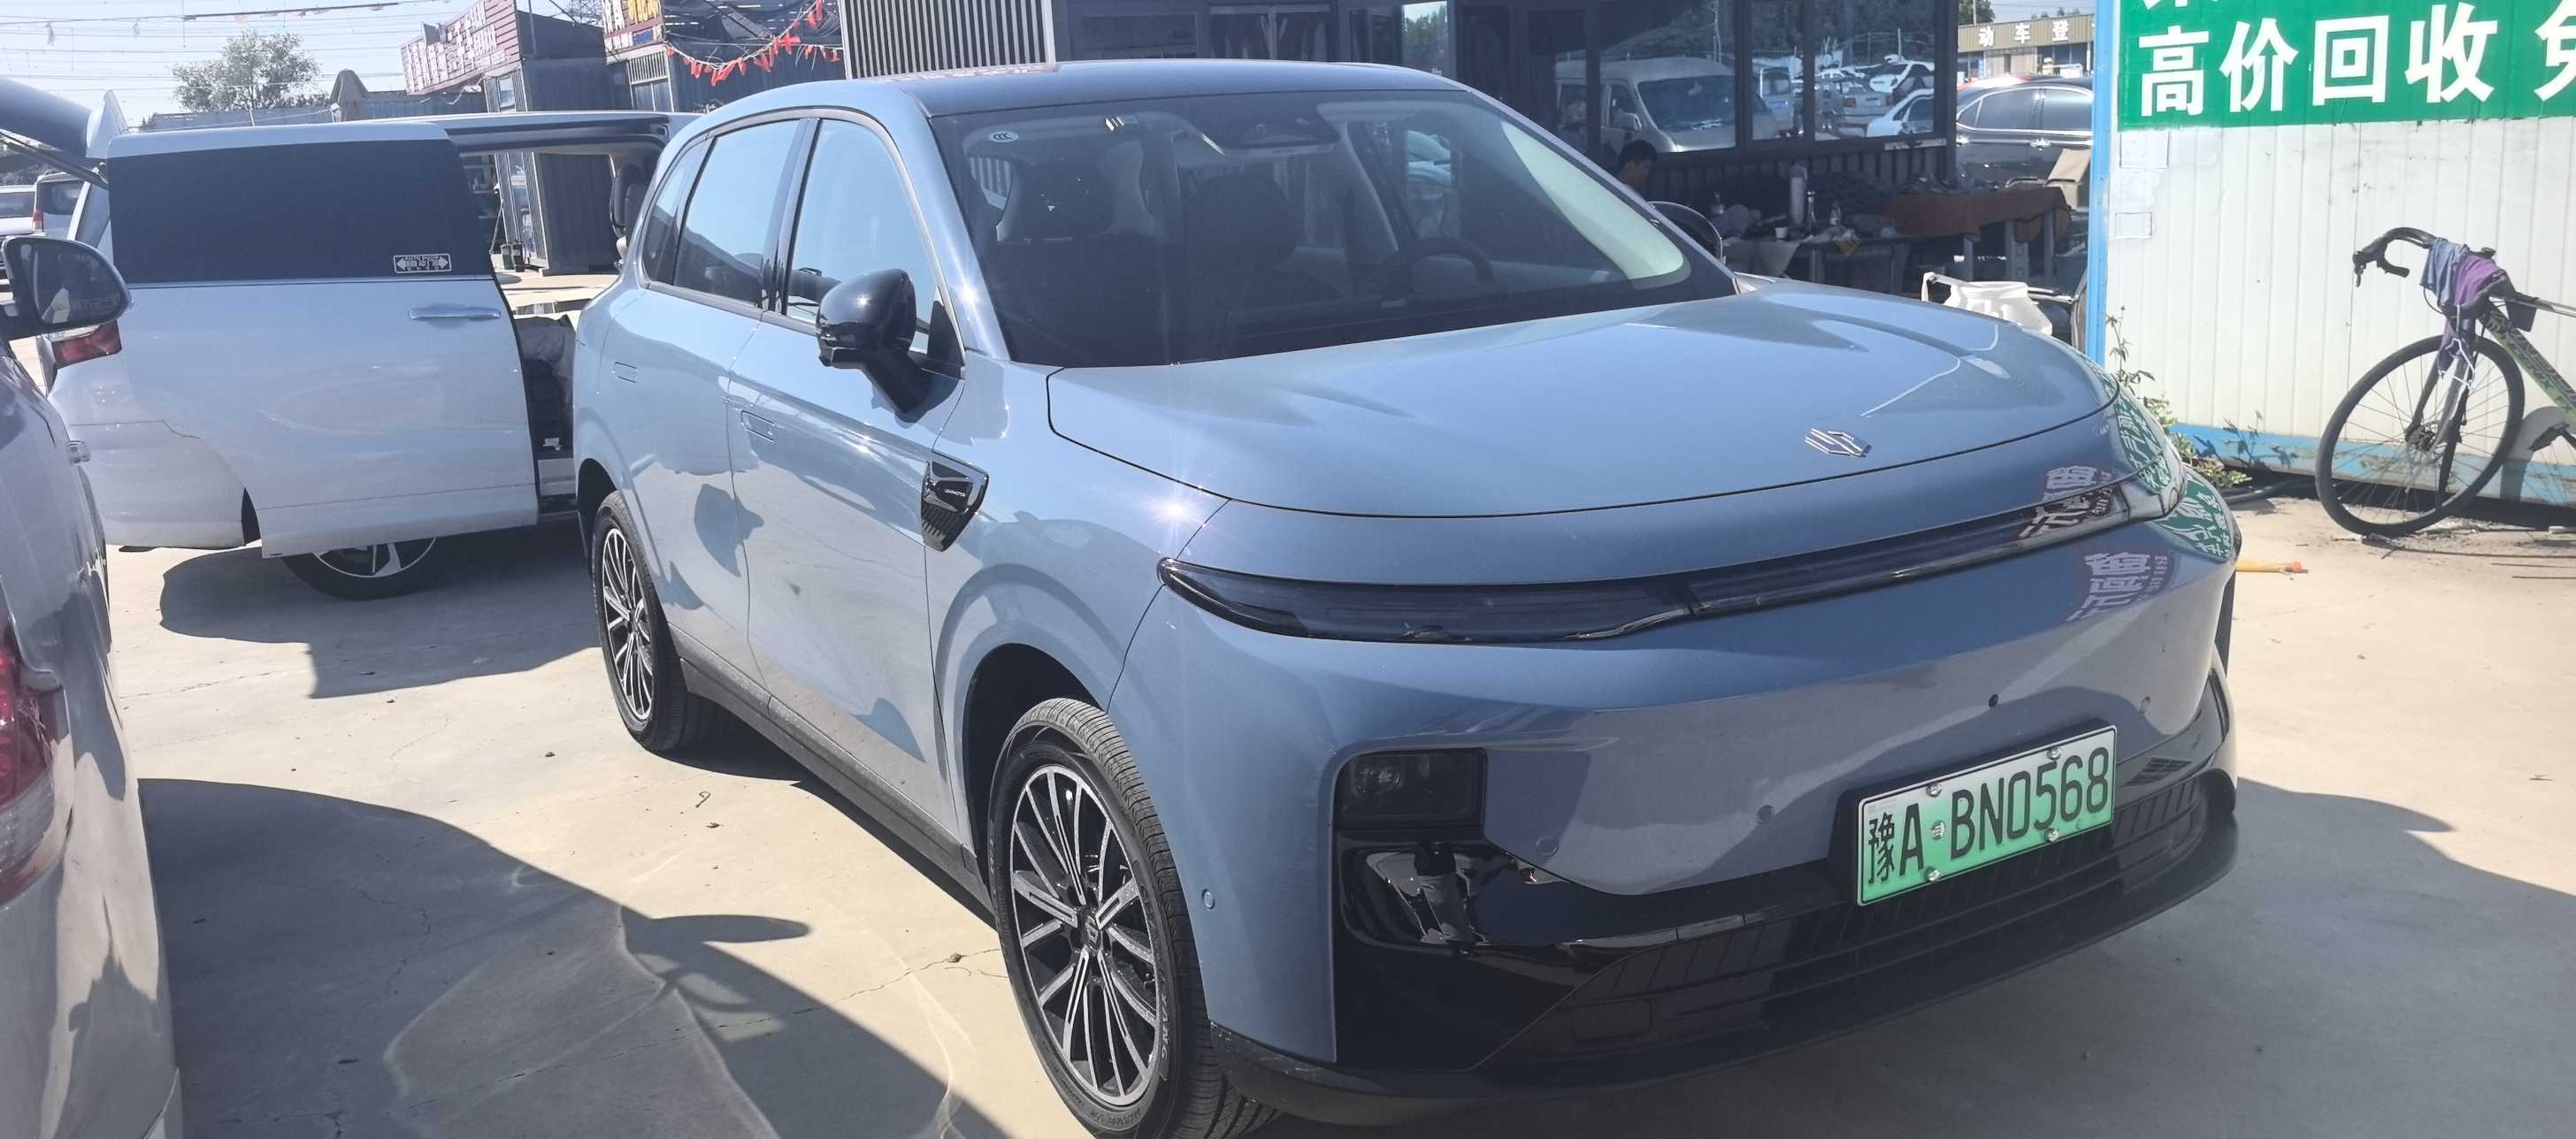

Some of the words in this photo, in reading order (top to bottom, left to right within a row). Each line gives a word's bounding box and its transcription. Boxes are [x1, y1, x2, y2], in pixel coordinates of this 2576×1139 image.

[1978, 19, 2096, 47] 动车登
[2138, 2, 2498, 117] 高价回收
